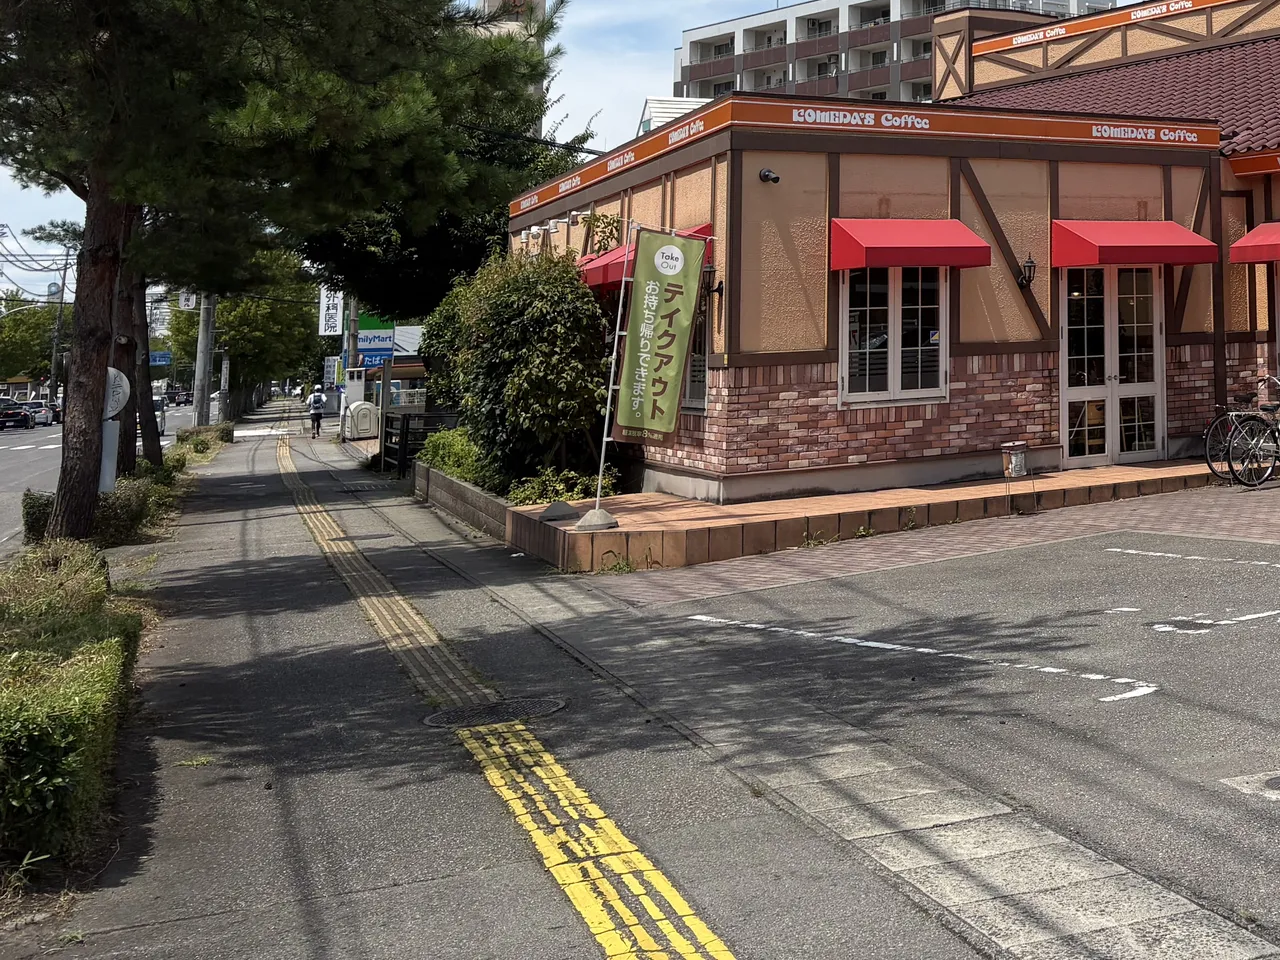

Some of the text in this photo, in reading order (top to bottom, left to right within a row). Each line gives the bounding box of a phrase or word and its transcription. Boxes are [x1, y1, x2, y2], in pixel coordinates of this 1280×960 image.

[1169, 0, 1193, 12] Coffee
[792, 108, 930, 130] KOMEDA'S Coffee
[1091, 125, 1198, 143] KOMEDA'S Coffee
[660, 251, 680, 263] Take
[660, 261, 677, 271] Out
[650, 282, 684, 420] テイクアウト
